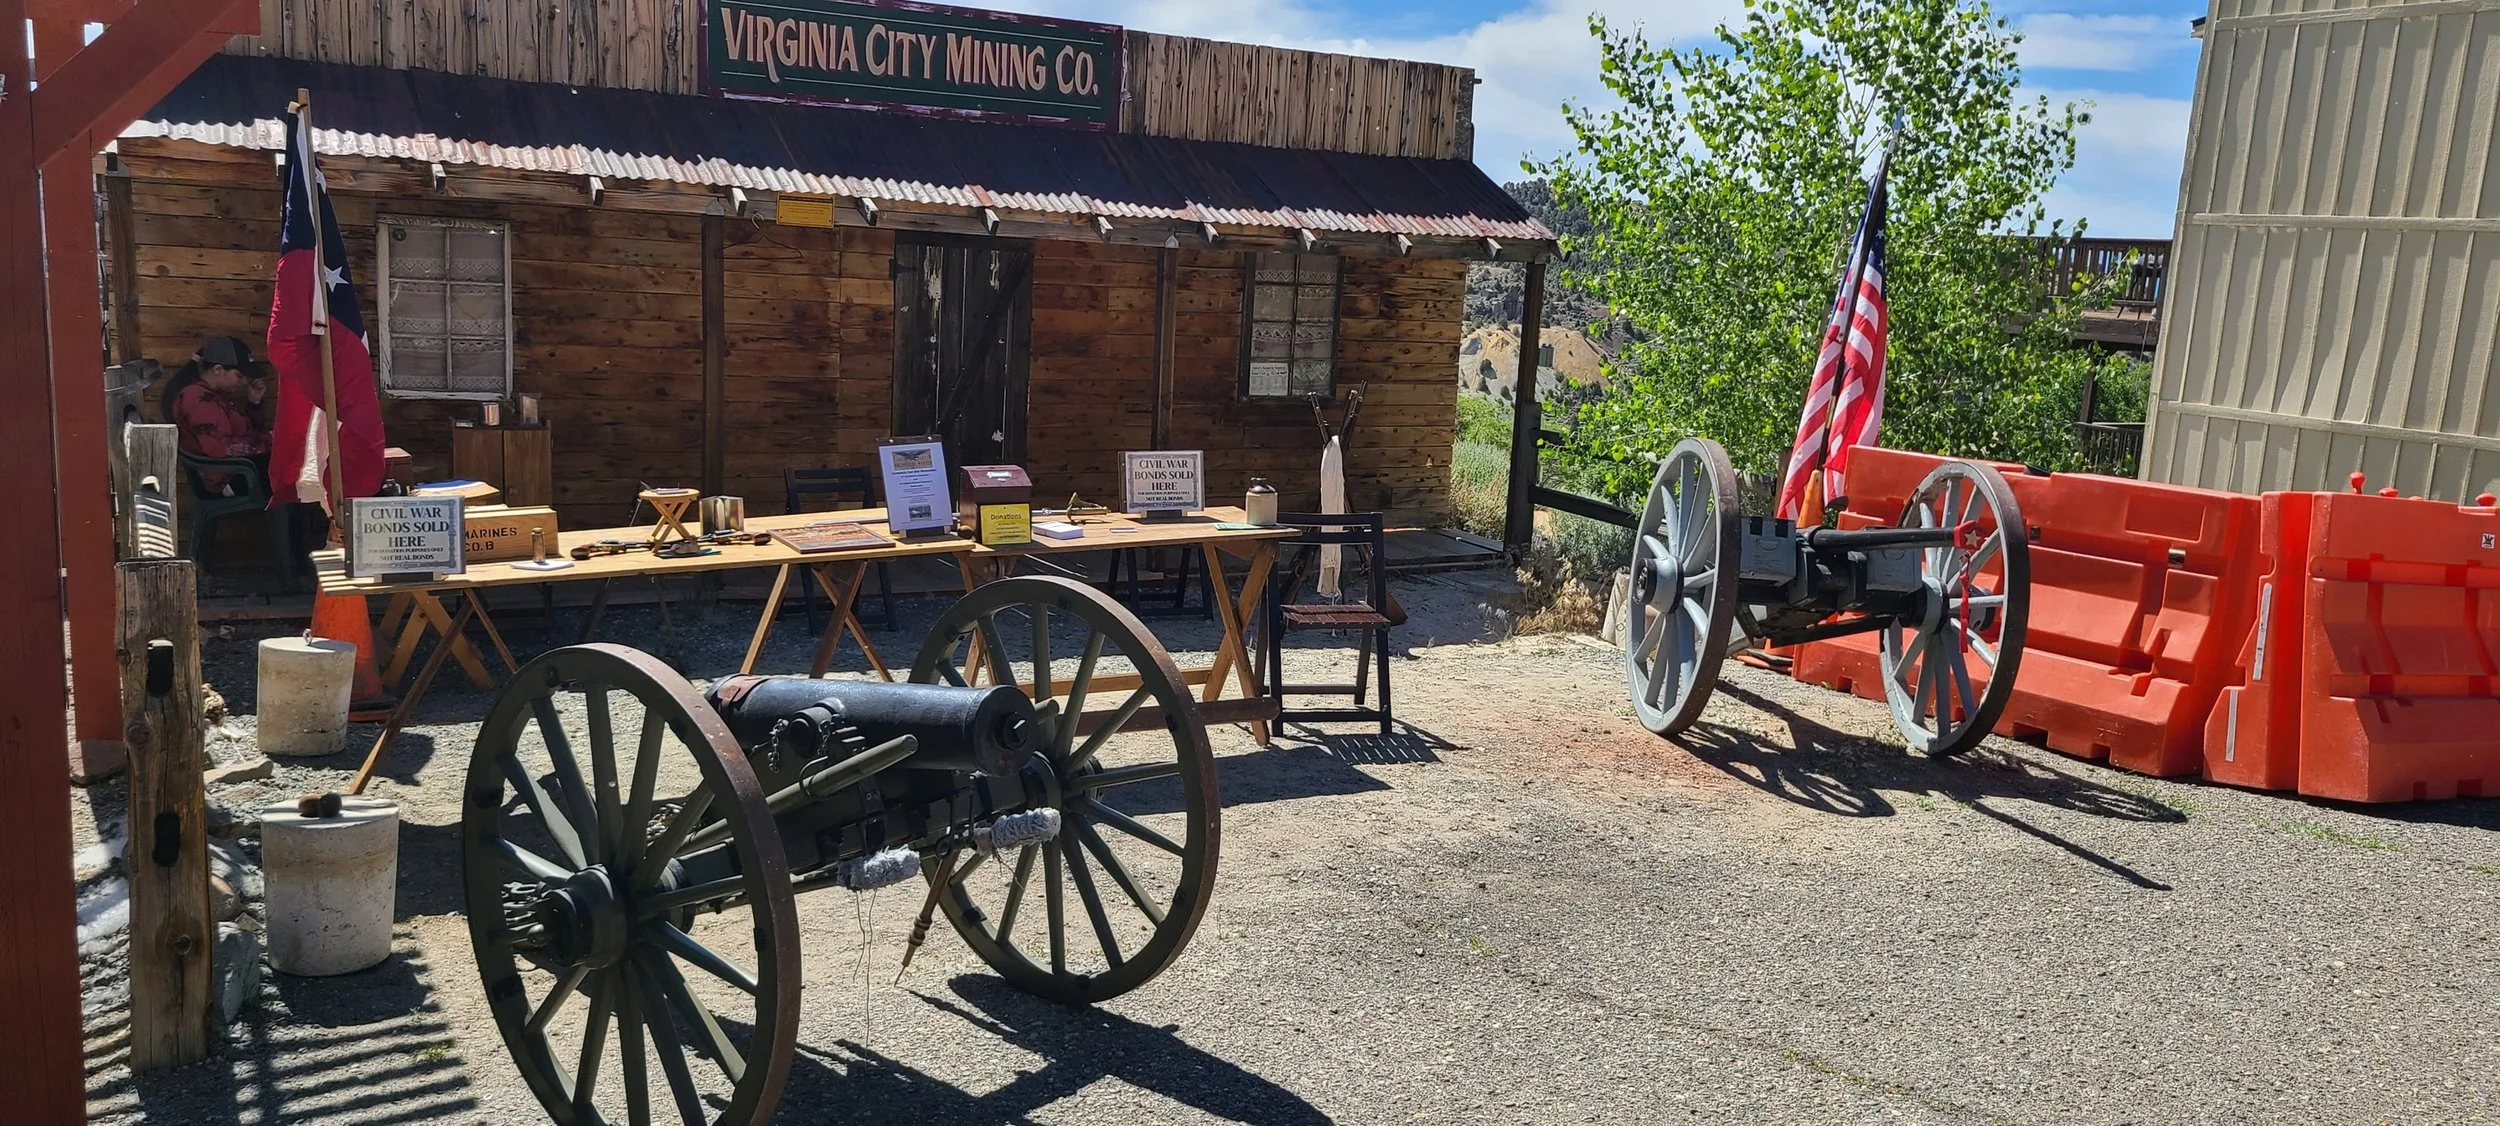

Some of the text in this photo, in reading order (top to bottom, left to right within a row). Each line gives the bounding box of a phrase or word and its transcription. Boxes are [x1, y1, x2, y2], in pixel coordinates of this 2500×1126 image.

[720, 7, 1099, 96] VIRGINIA CITY MINING CO.
[1139, 460, 1188, 469] CIVIL WAR
[1134, 470, 1194, 480] BONDS SOLD
[1151, 482, 1178, 491] HERE
[371, 507, 442, 519] CIVIL WAR
[364, 521, 449, 534] BONDS SOLD
[388, 535, 426, 548] HERE
